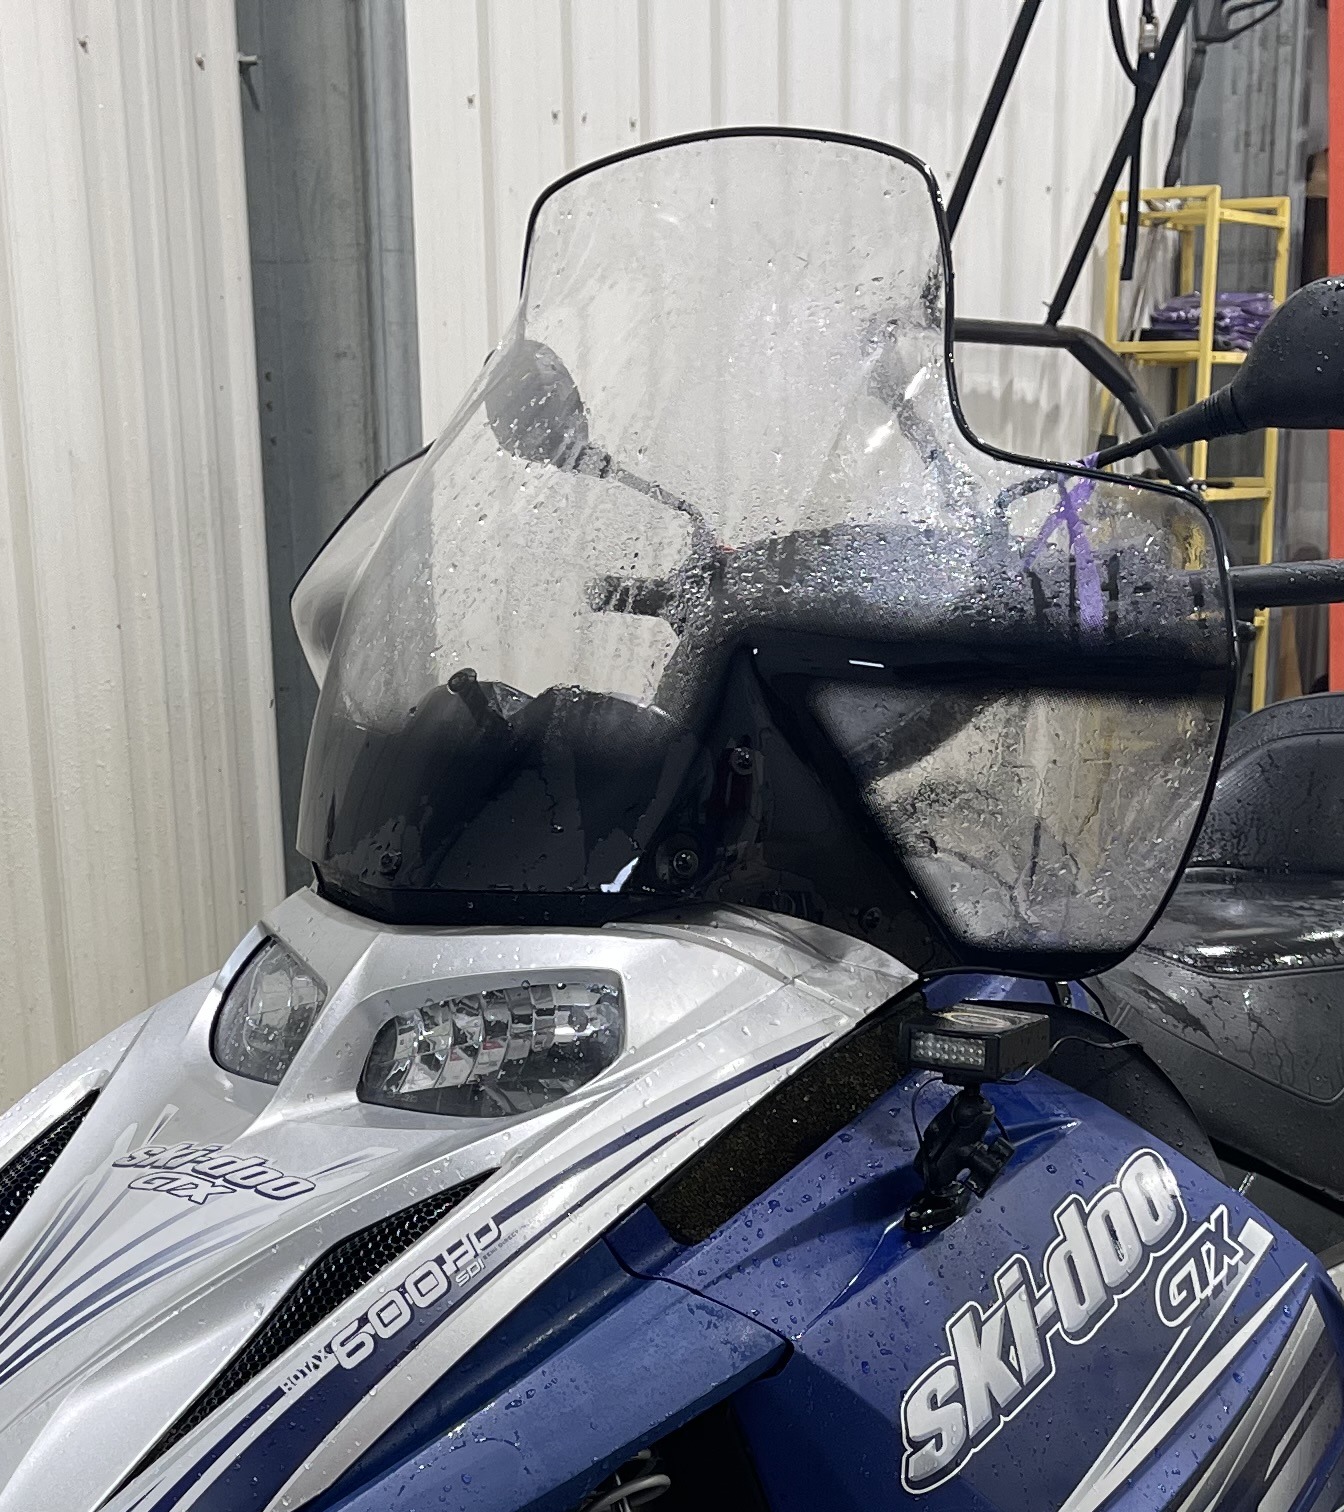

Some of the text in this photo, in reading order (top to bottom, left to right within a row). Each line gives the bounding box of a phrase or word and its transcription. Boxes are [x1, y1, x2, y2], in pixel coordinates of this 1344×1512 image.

[128, 1171, 237, 1205] GTX
[456, 1258, 486, 1287] SDI
[1156, 1205, 1244, 1327] GTX
[283, 1343, 336, 1394] ROTAX
